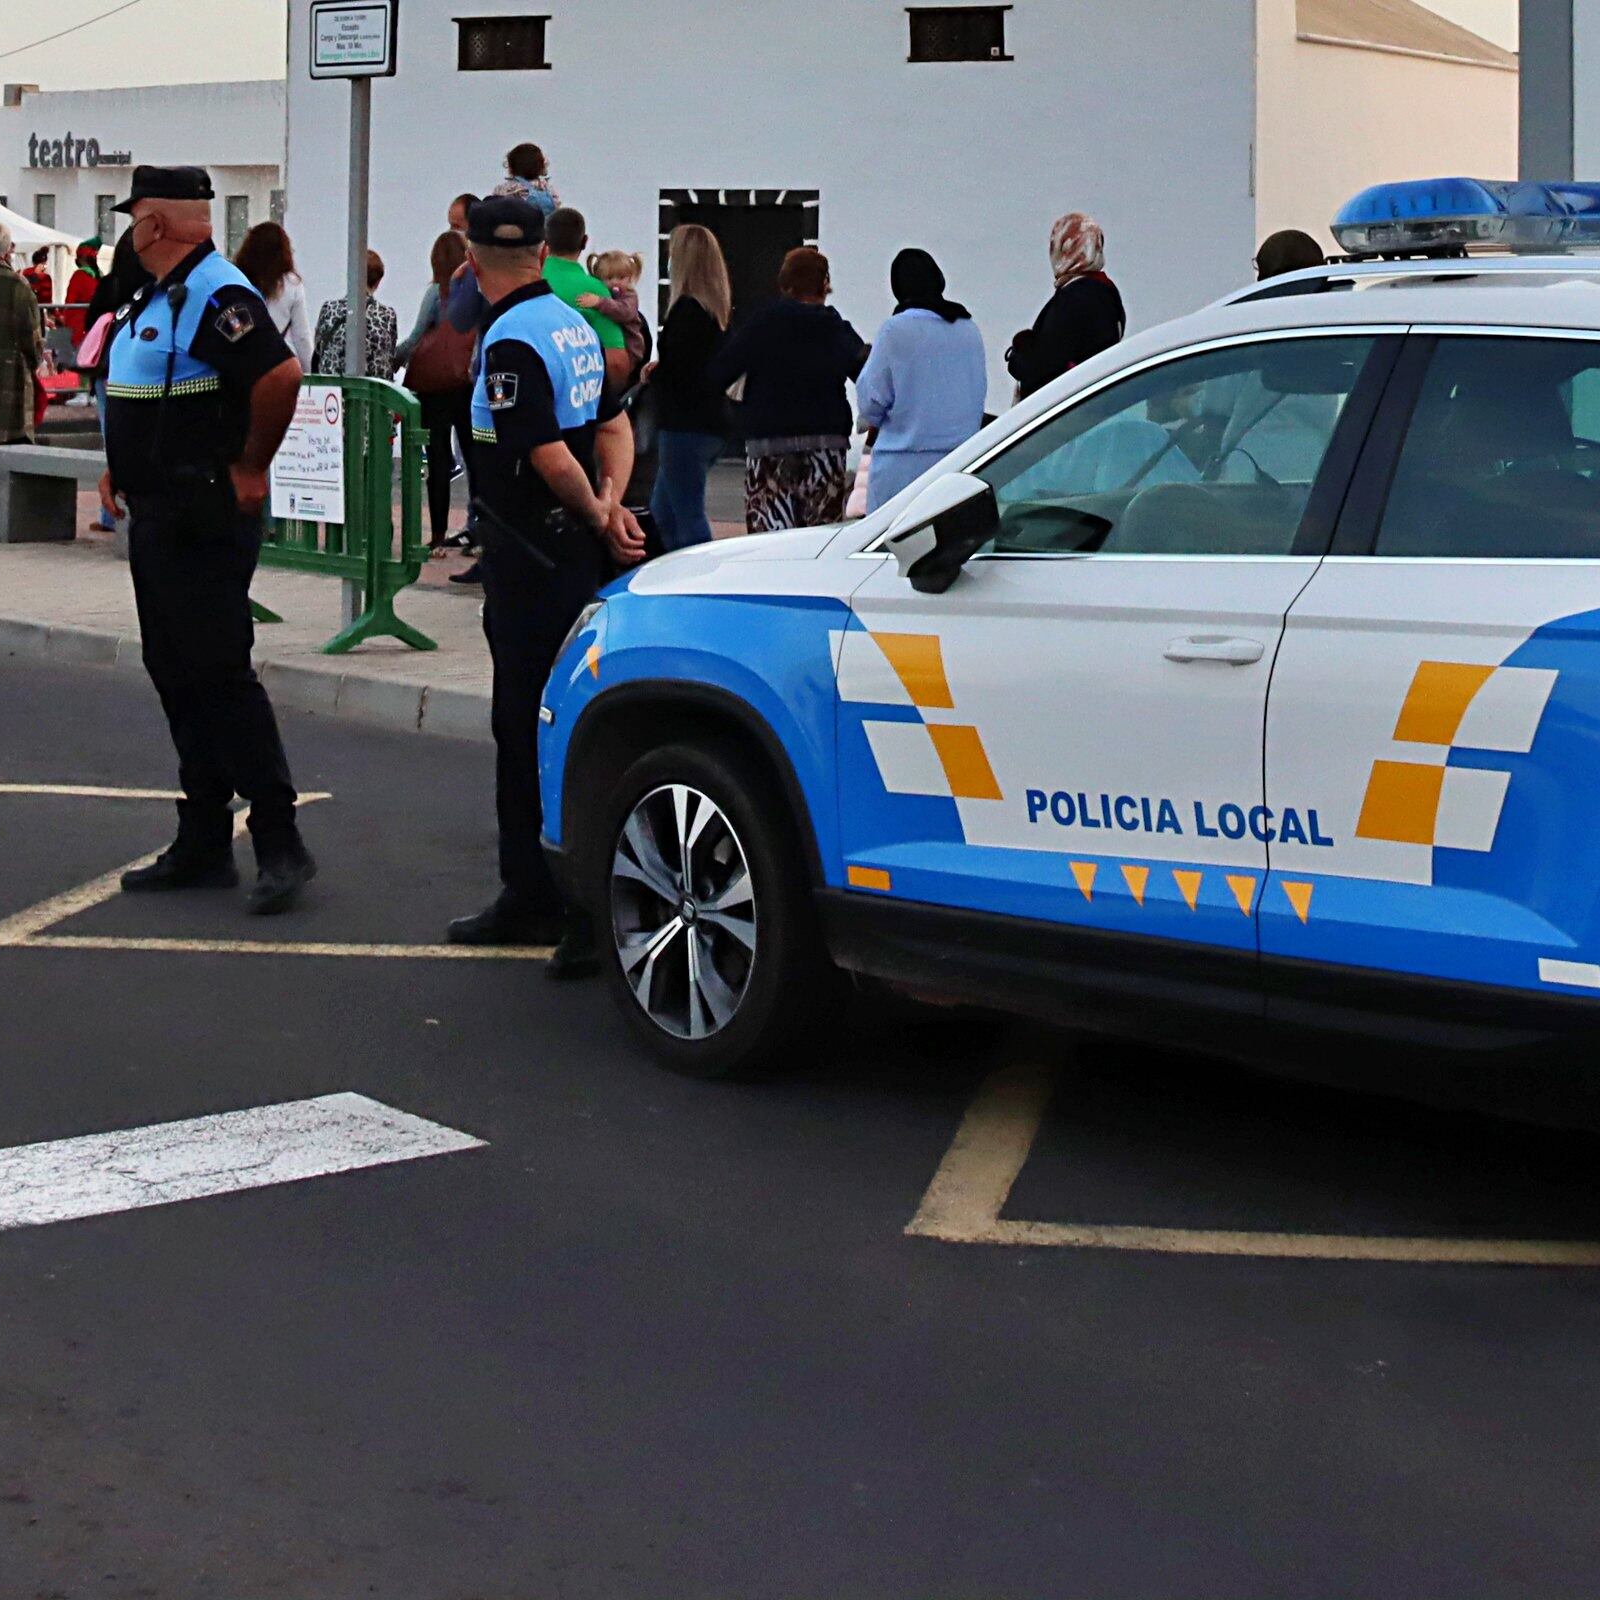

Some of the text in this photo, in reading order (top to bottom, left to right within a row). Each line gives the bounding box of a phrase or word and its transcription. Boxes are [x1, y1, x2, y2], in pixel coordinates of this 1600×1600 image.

[28, 131, 99, 168] teatro
[1026, 789, 1334, 847] POLICIA LOCAL
